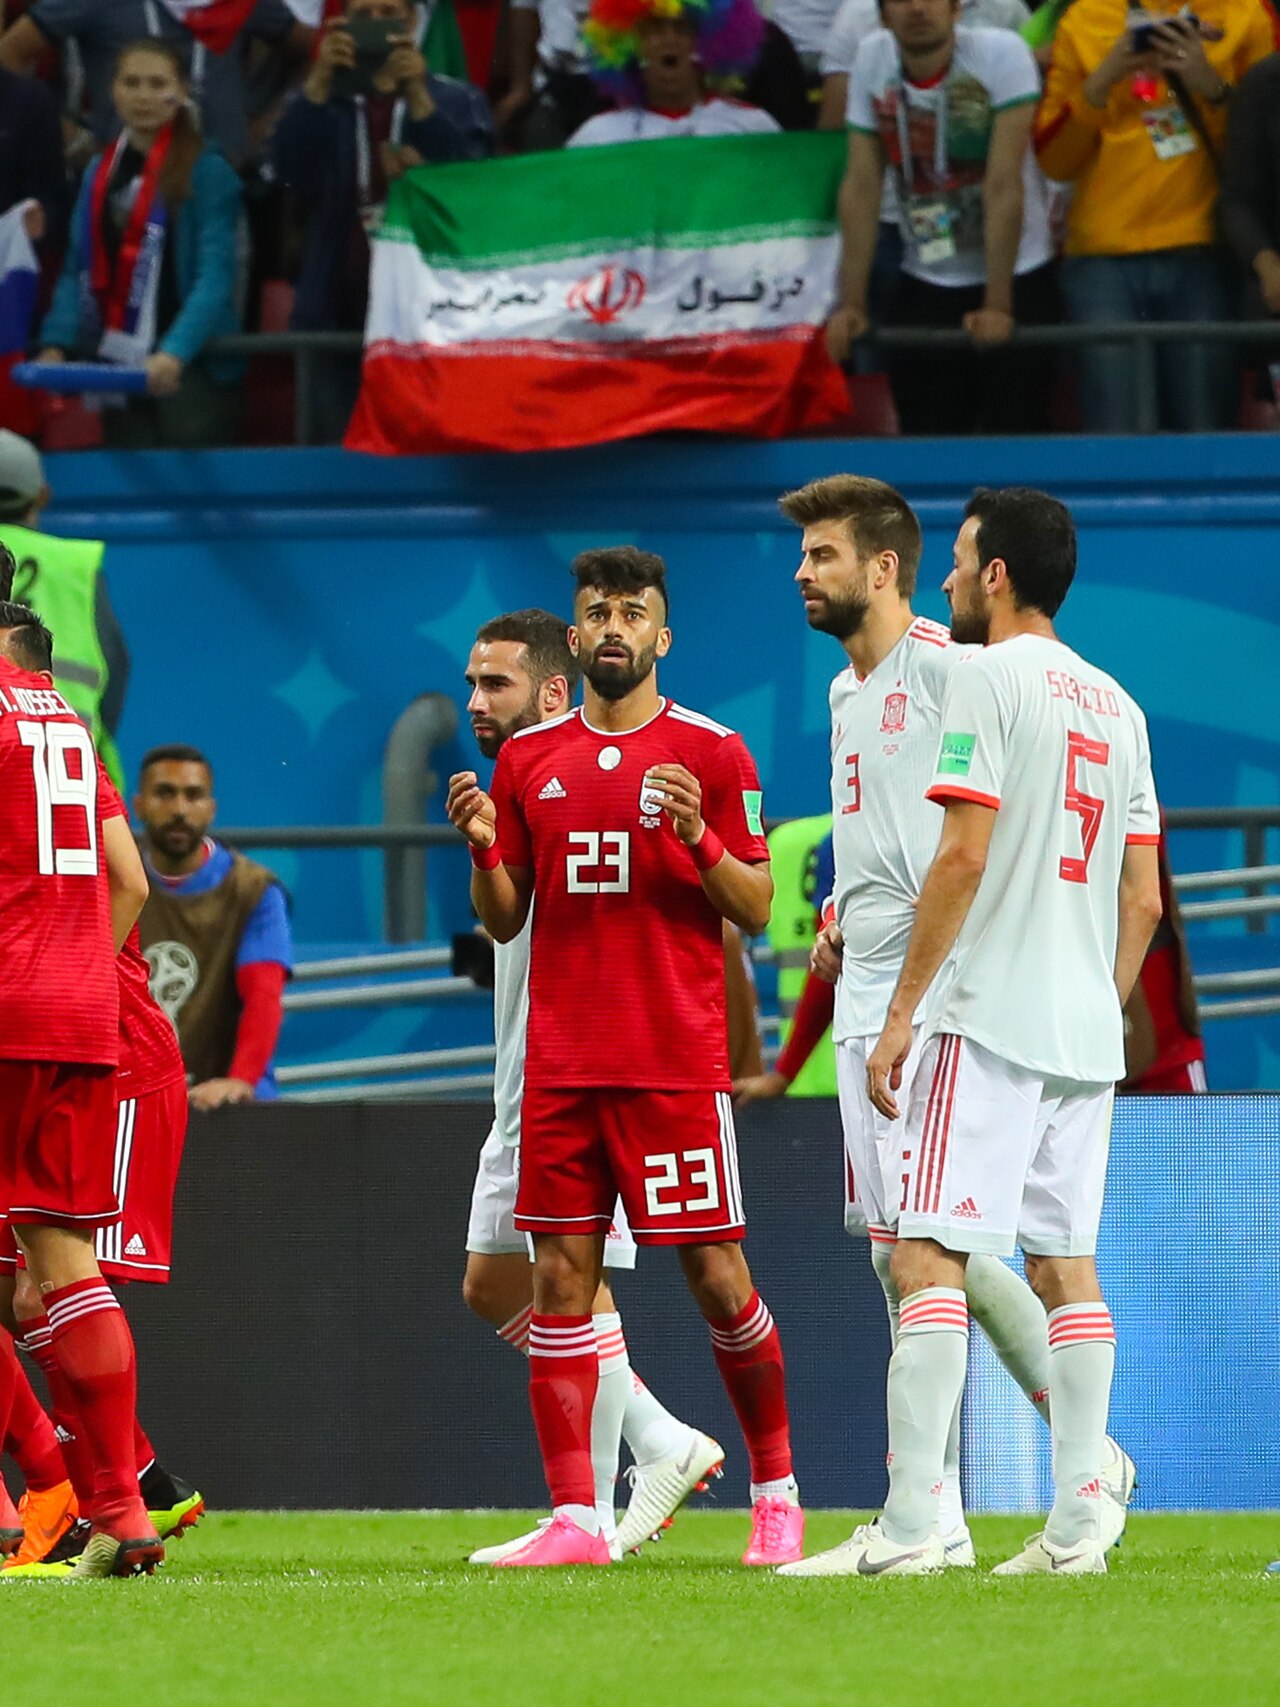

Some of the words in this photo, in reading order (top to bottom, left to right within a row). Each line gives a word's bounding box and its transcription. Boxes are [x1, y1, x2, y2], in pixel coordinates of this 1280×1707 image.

[16, 720, 99, 876] 19
[842, 753, 860, 815] 3
[1059, 729, 1110, 883] 5
[567, 831, 630, 893] 23
[644, 1147, 720, 1216] 23
[950, 1207, 982, 1220] adidas
